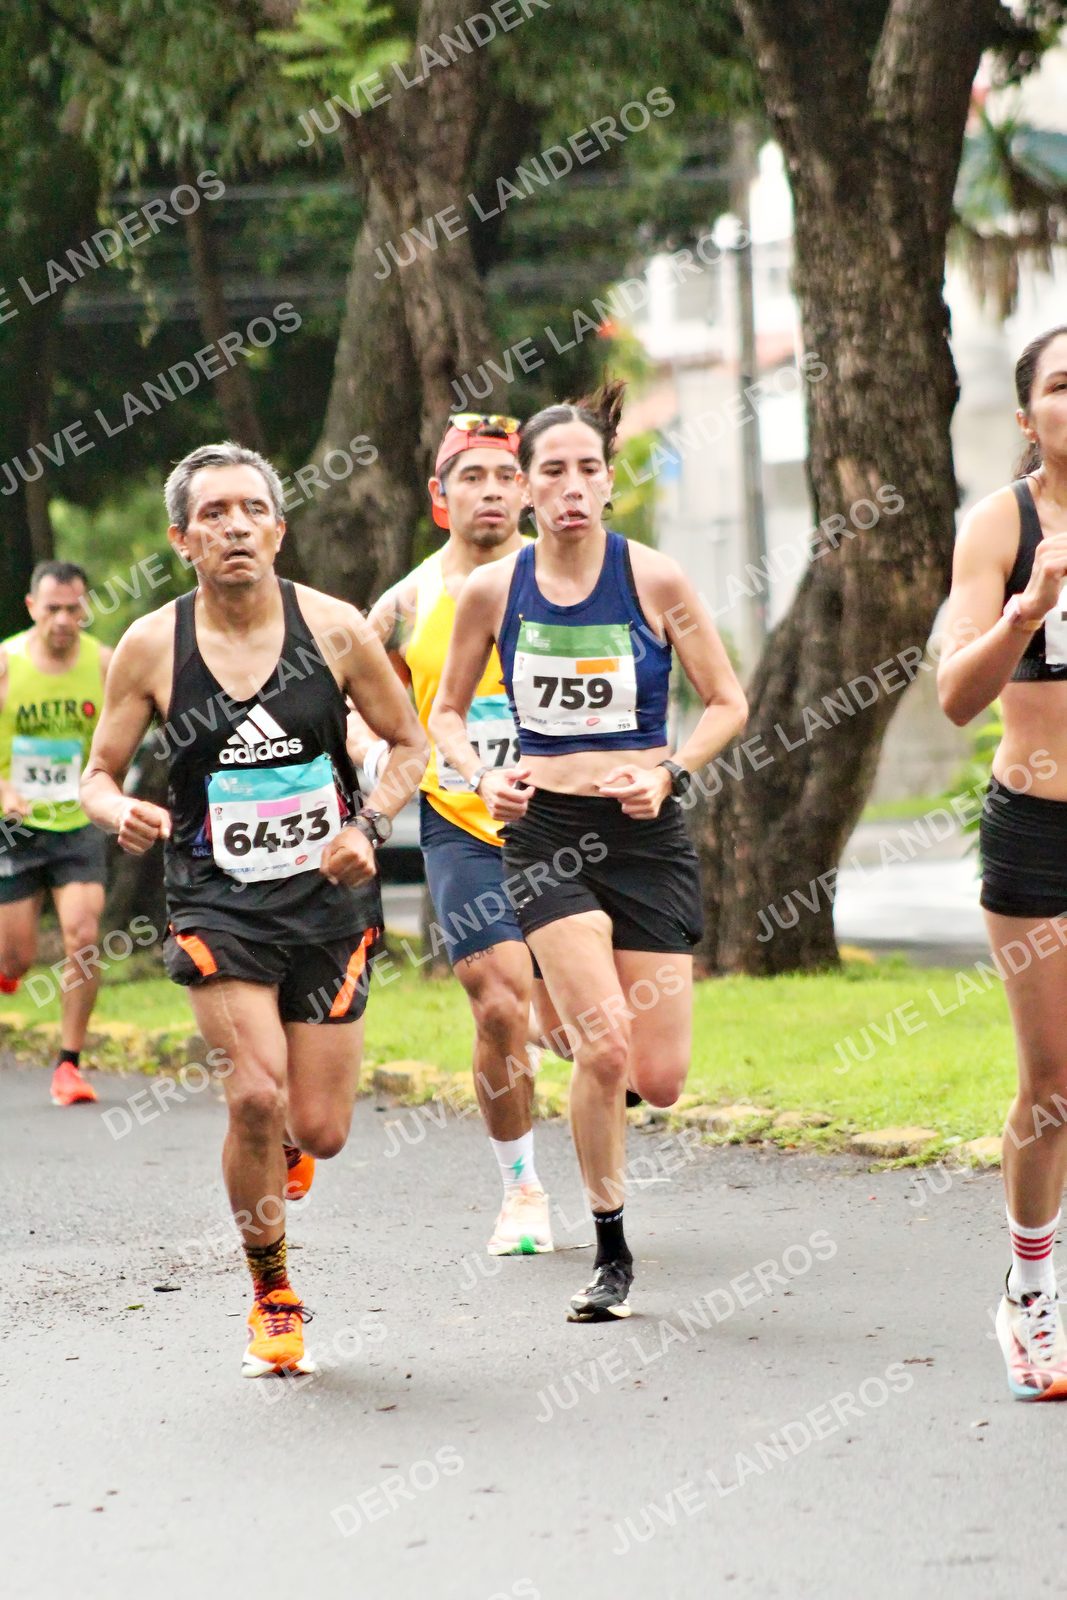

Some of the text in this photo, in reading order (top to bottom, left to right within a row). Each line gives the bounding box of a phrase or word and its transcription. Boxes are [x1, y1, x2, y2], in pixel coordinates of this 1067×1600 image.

[533, 676, 613, 710] 759
[219, 738, 303, 764] adidas
[223, 806, 330, 857] 6433
